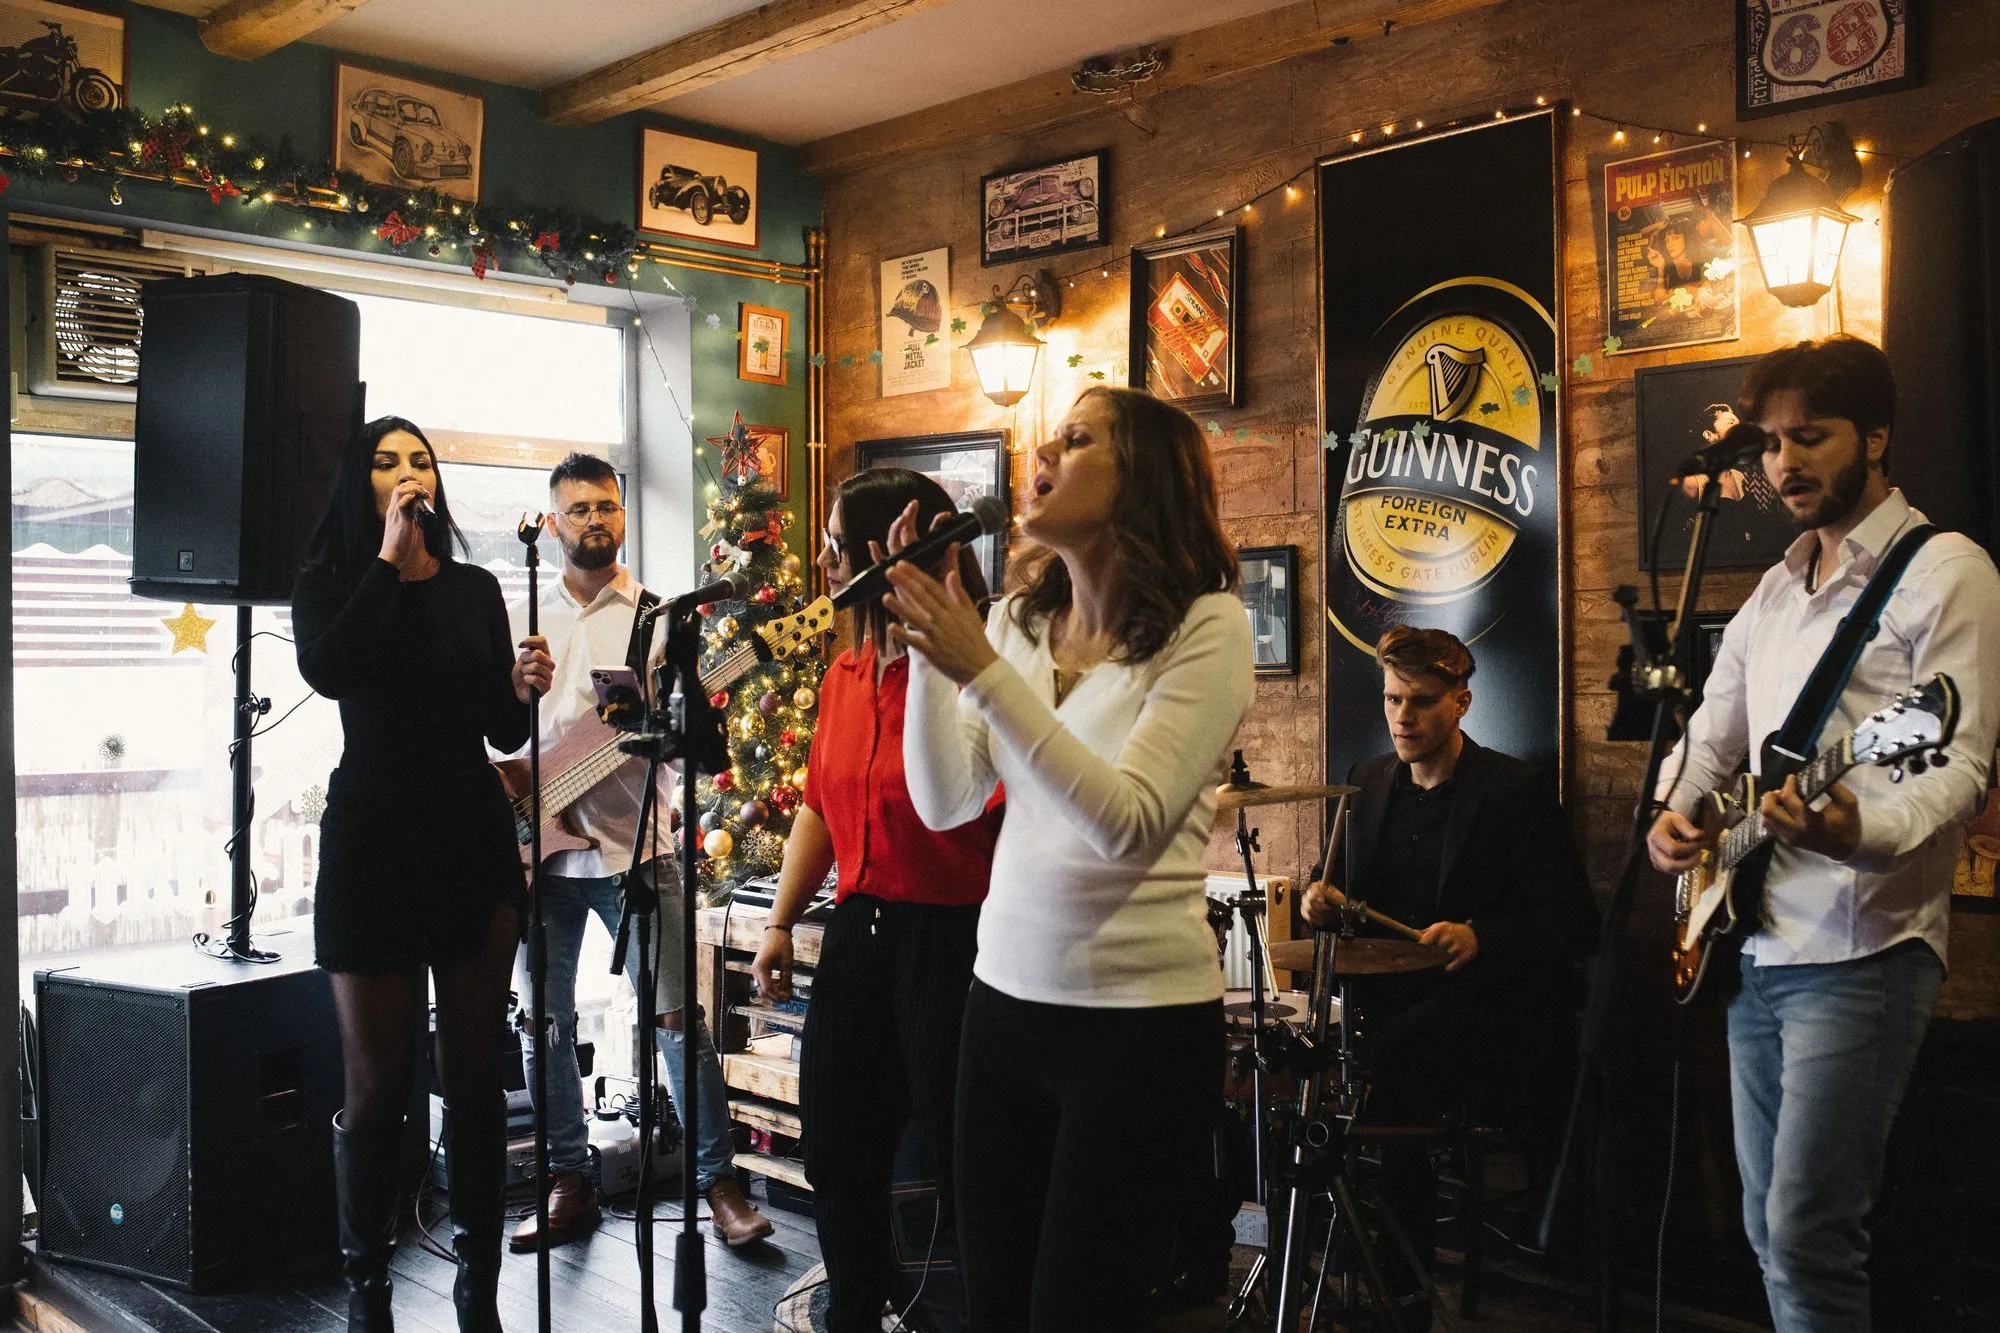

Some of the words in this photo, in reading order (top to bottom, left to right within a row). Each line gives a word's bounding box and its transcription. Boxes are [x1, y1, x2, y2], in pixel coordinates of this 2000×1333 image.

[1615, 172, 1657, 202] PULP
[1659, 159, 1724, 193] FICTION
[904, 359, 925, 369] JACKET
[905, 351, 923, 361] METAL
[1387, 323, 1465, 386] GENUINE
[1475, 327, 1530, 396] QUALIT
[1347, 427, 1538, 517] GUINNESS
[1380, 495, 1467, 526] FOREIGN
[1384, 514, 1449, 541] EXTRA
[1400, 567, 1442, 580] GATE
[1451, 530, 1500, 575] DUBLIN
